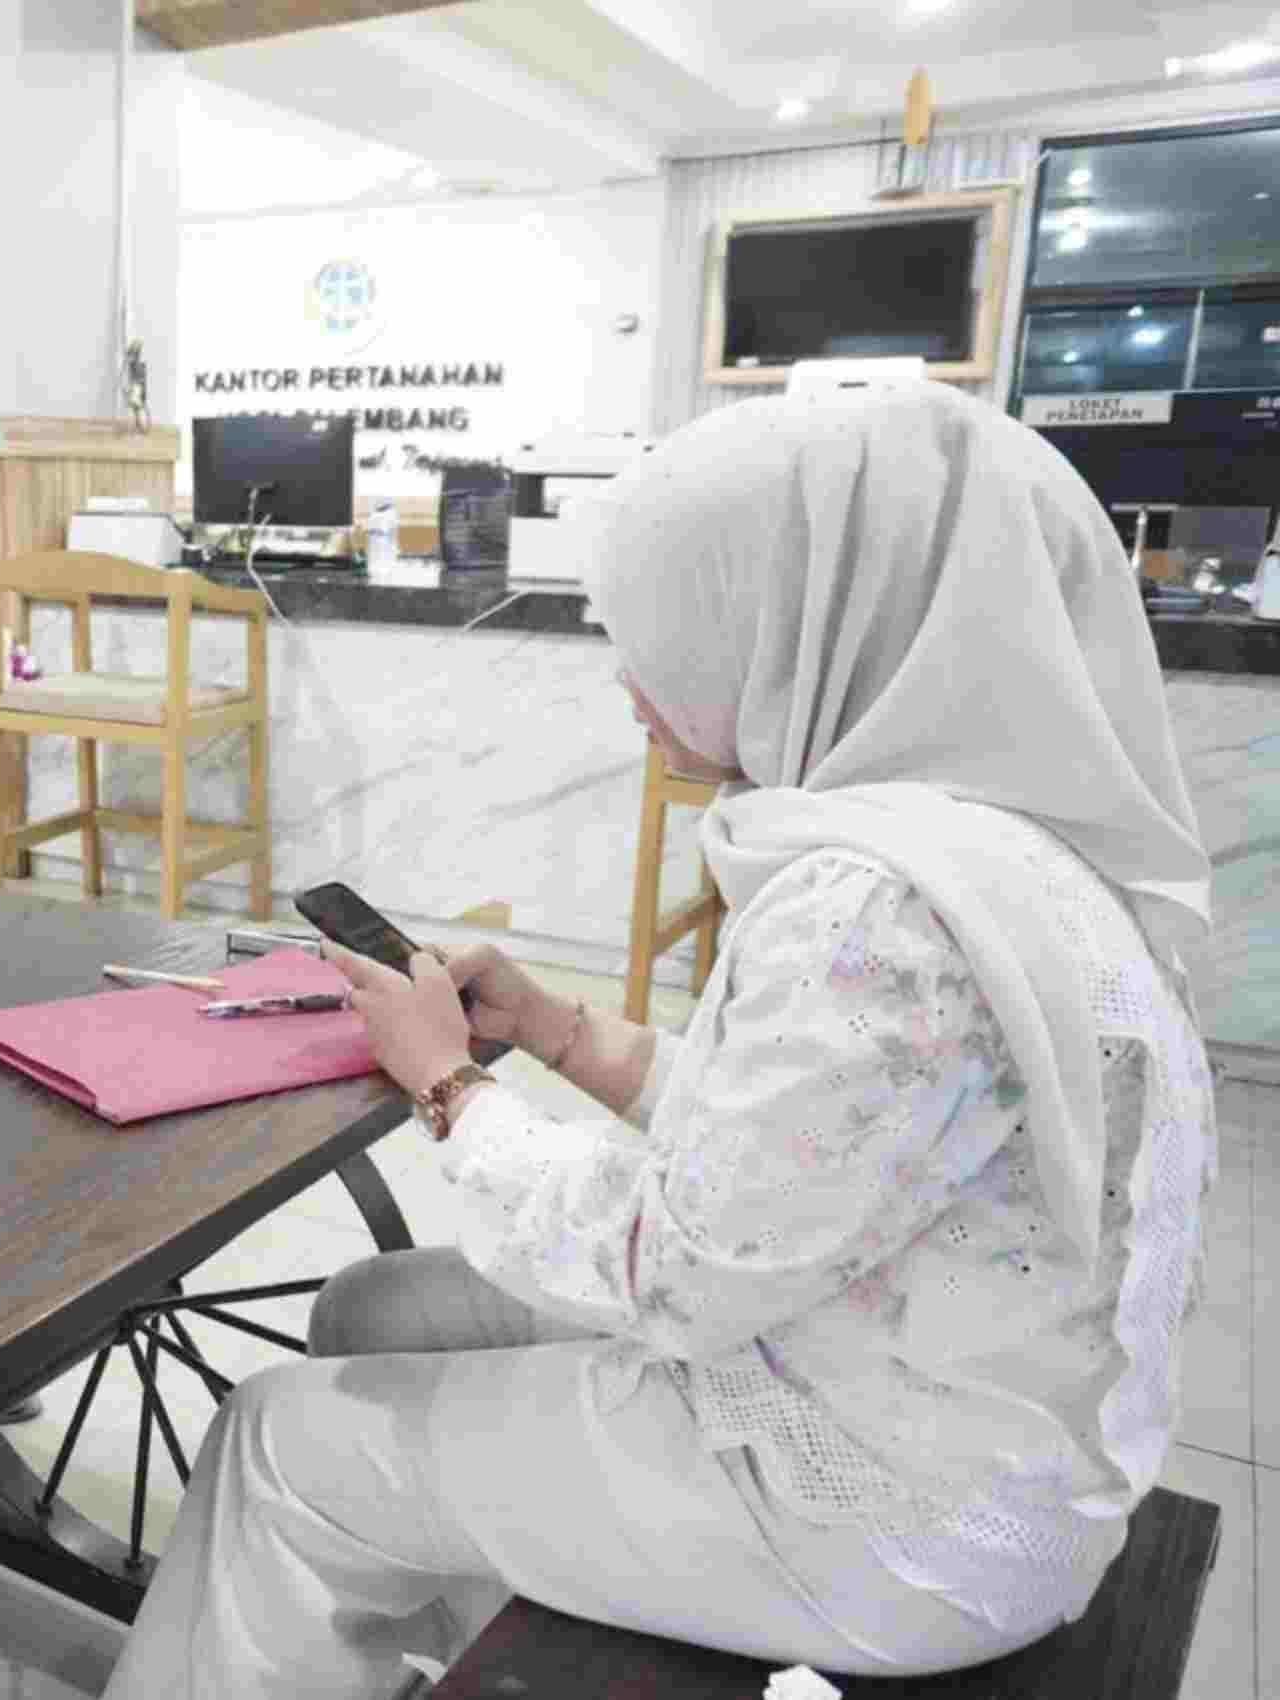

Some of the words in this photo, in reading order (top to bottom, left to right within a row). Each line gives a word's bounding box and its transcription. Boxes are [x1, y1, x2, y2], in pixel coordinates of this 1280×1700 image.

[195, 367, 298, 393] KANTOR
[309, 362, 503, 391] PERTANAHAN
[296, 406, 469, 432] EMBANG
